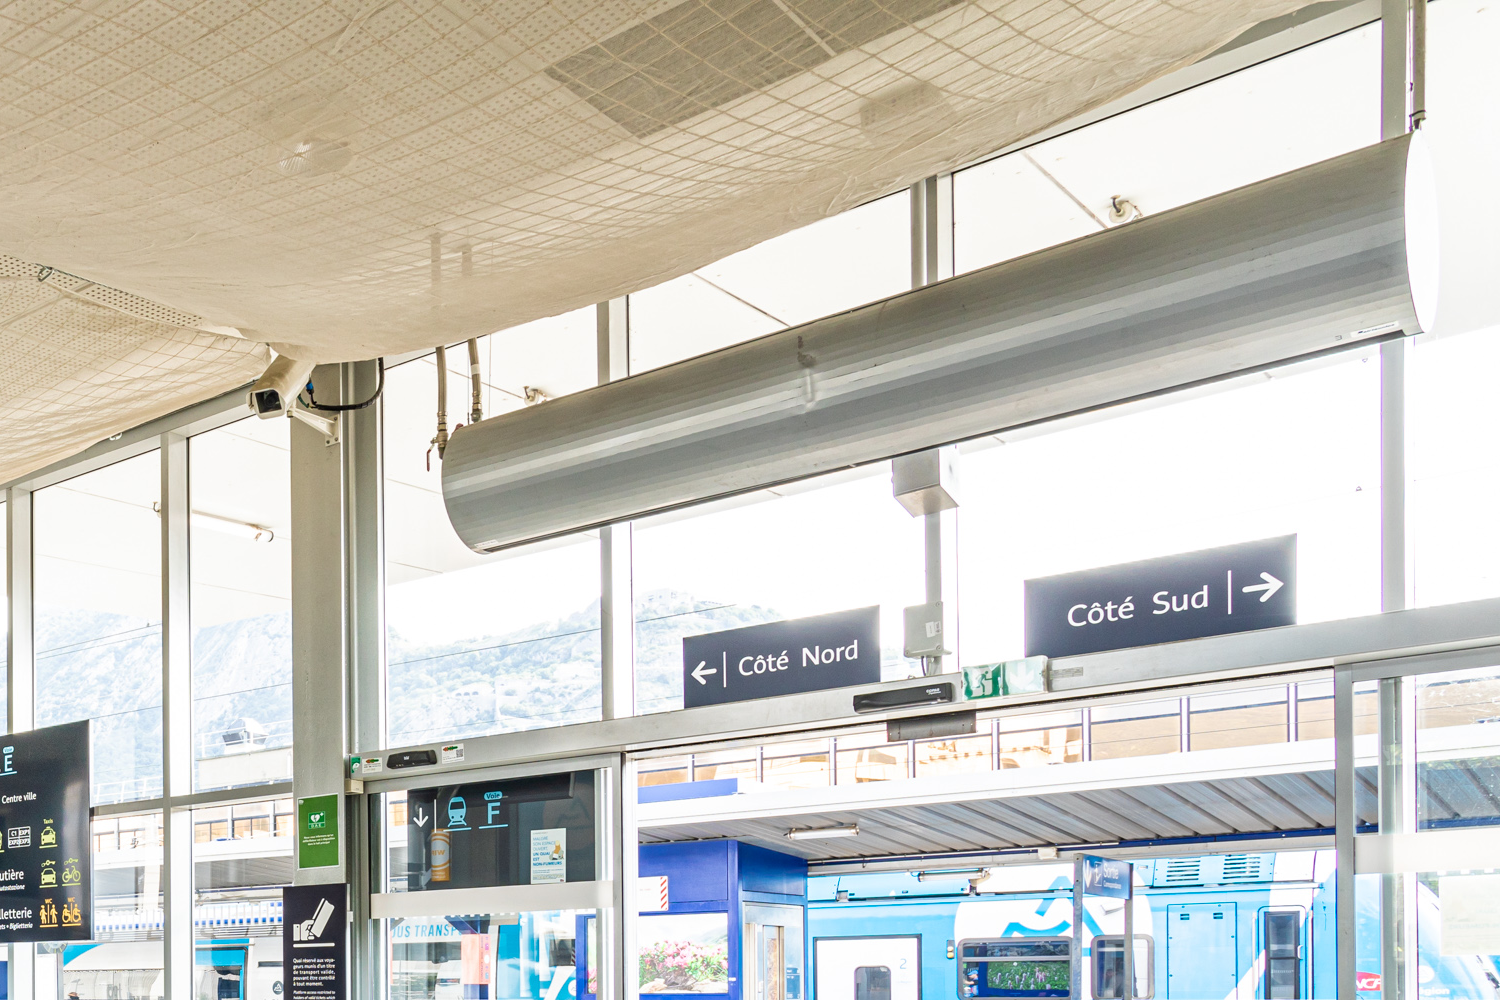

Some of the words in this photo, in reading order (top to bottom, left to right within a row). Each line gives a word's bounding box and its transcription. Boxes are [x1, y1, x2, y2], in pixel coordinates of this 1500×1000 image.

[1067, 596, 1135, 627] Côté
[1152, 584, 1209, 615] Sud
[738, 650, 789, 676] Côté
[802, 639, 858, 667] Nord
[4, 754, 13, 772] E
[1, 795, 22, 804] Centre
[23, 791, 37, 800] ville
[487, 802, 501, 824] F
[1103, 862, 1119, 880] Sortie
[415, 924, 461, 937] TRANSP
[899, 958, 907, 969] 2
[1356, 979, 1381, 989] NCF
